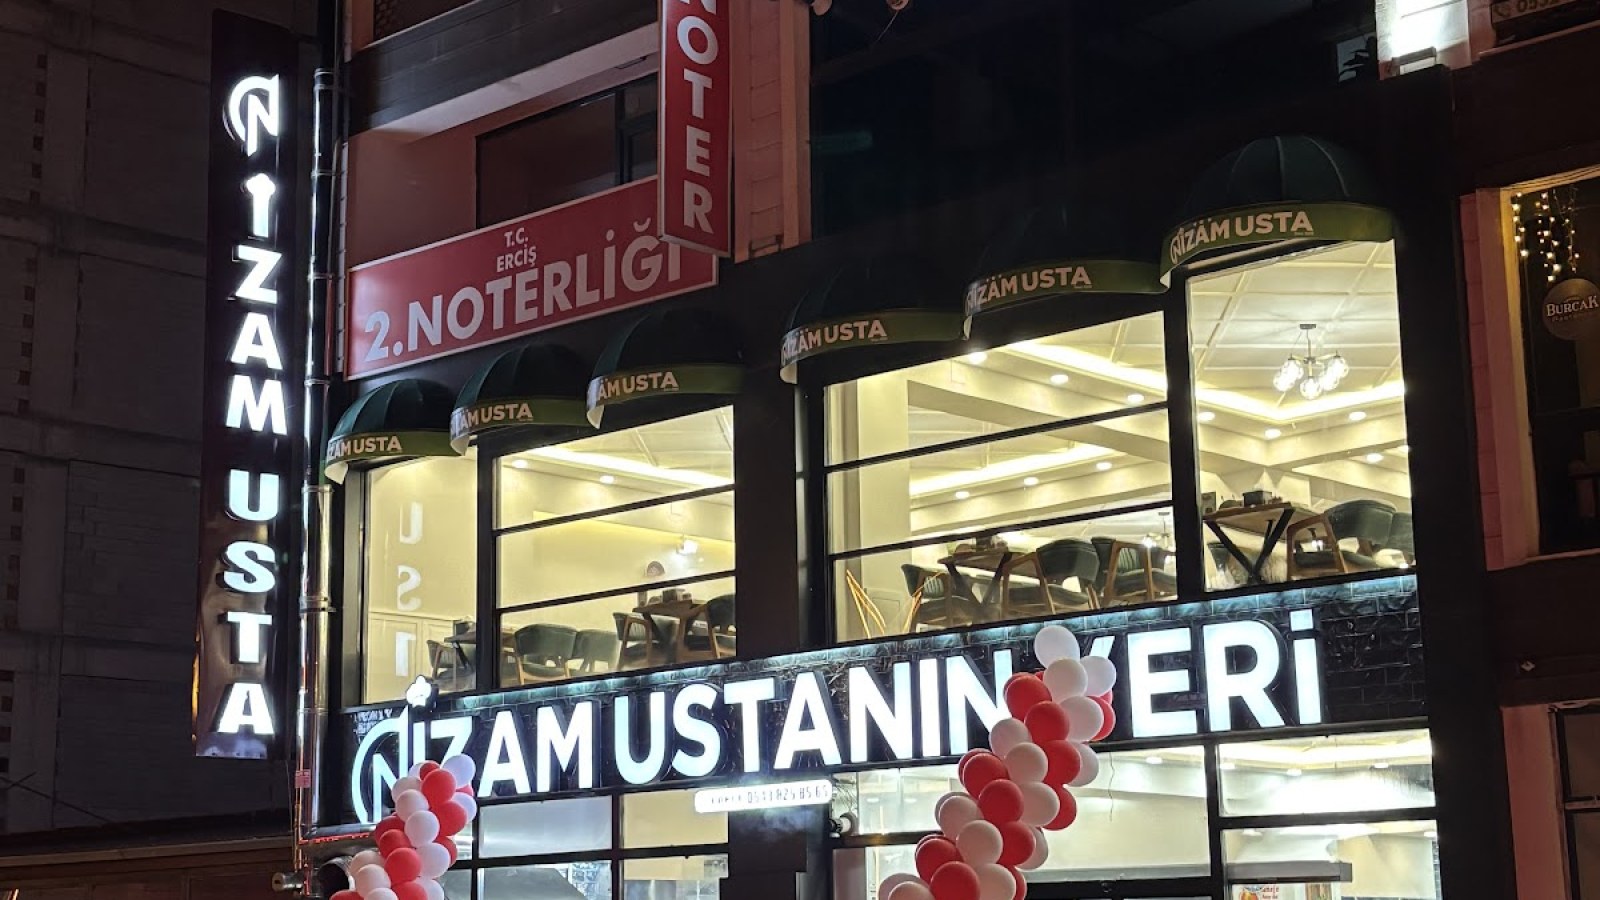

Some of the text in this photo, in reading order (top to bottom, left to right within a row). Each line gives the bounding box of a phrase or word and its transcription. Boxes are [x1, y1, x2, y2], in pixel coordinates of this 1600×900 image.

[1235, 211, 1314, 237] USTA
[504, 227, 528, 248] T.C.
[496, 246, 537, 273] ERCİŞ
[1022, 266, 1092, 292] USTA
[824, 319, 887, 344] USTA
[622, 371, 679, 394] USTA
[481, 403, 533, 424] USTA
[353, 435, 402, 454] USTA
[217, 468, 280, 735] USTA
[613, 649, 1014, 785] USTANIN
[1087, 608, 1323, 740] ERİ
